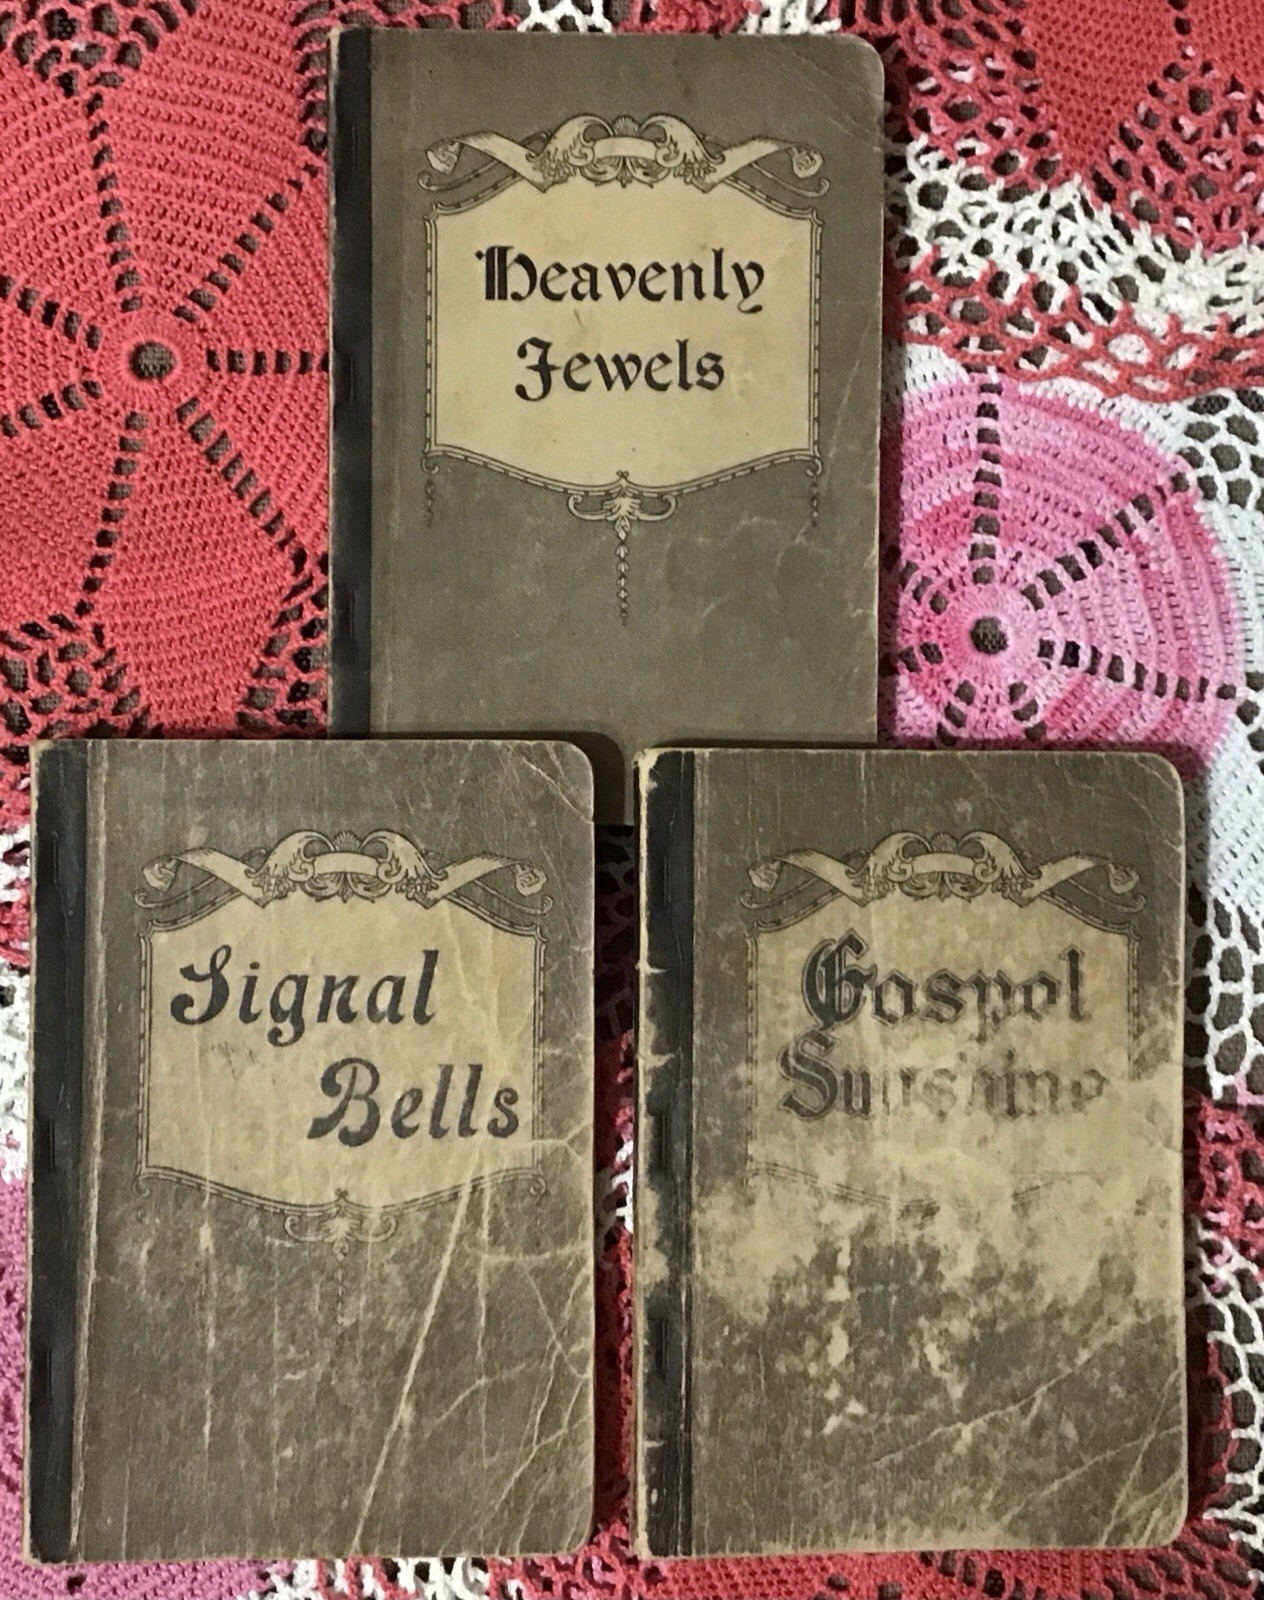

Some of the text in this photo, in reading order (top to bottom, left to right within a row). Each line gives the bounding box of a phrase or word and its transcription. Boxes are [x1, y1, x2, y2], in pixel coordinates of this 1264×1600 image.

[474, 245, 765, 314] Heavenly
[515, 337, 725, 401] Jewels
[170, 944, 439, 1047] Signal
[801, 928, 1093, 1044] Gospel
[306, 1057, 520, 1148] Bells
